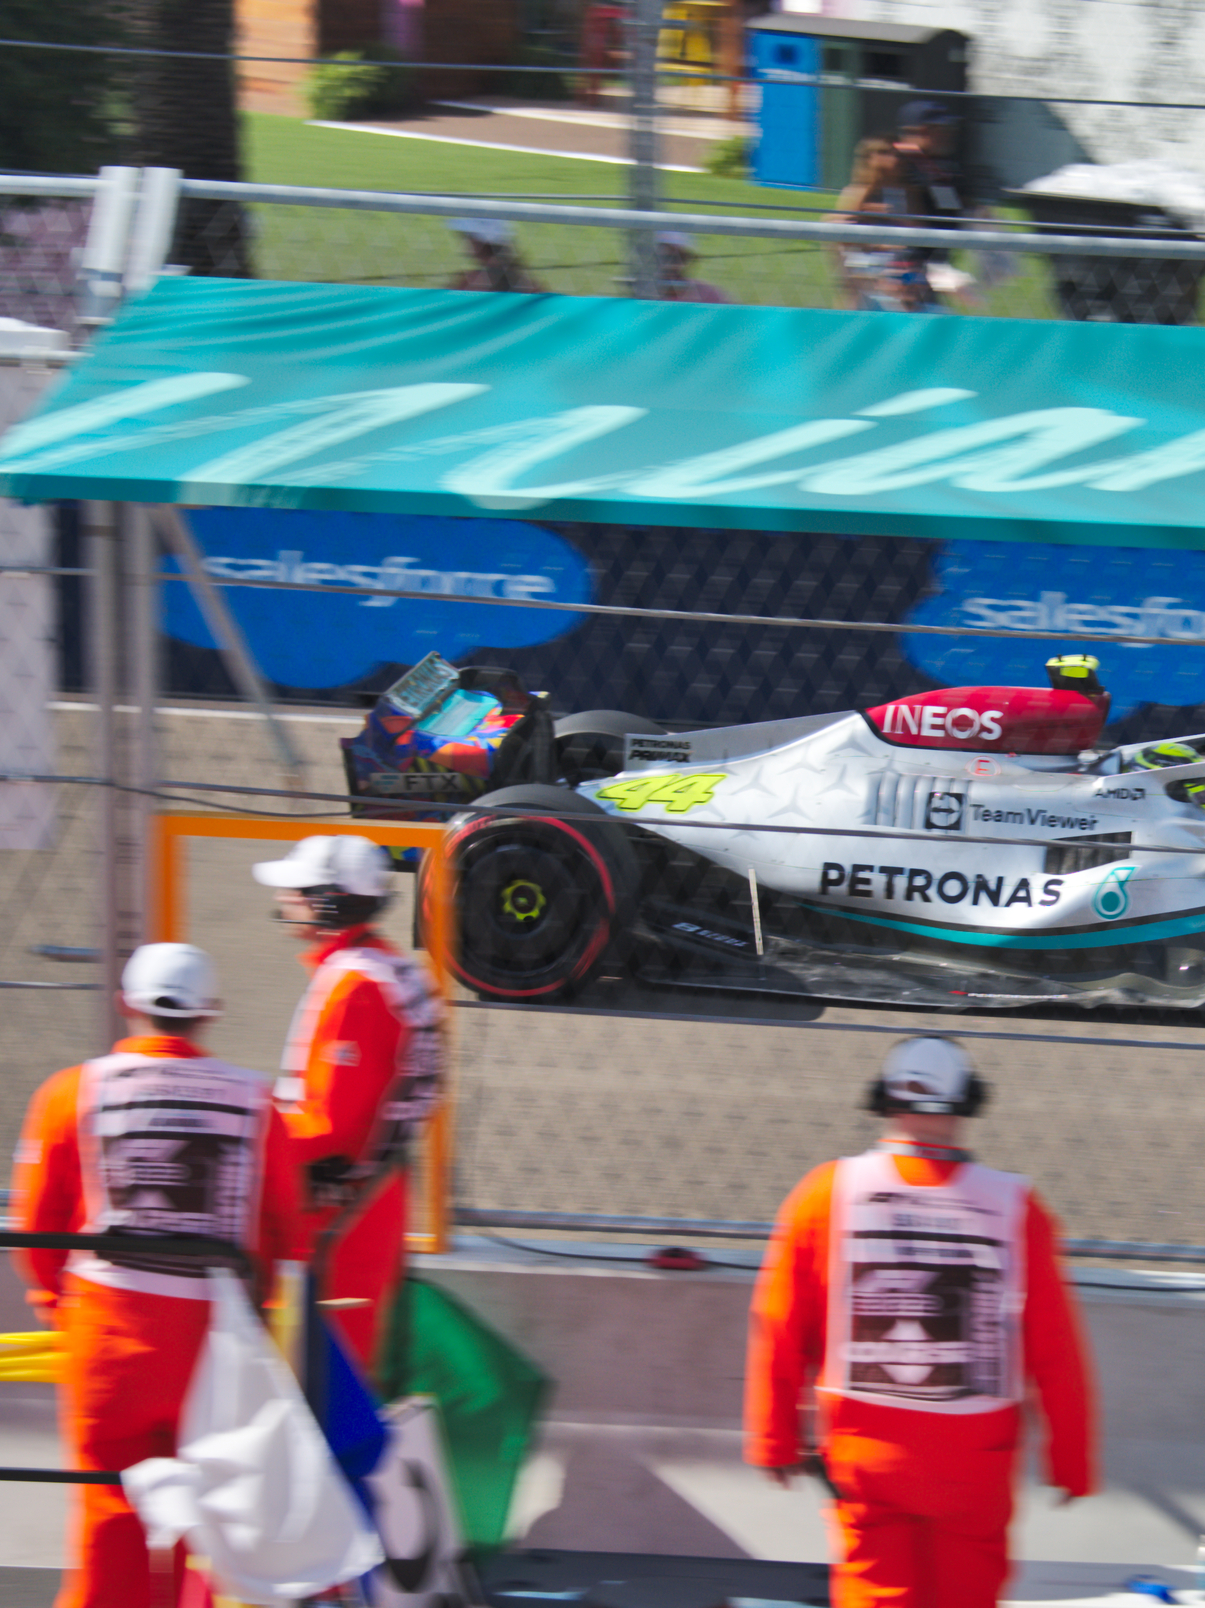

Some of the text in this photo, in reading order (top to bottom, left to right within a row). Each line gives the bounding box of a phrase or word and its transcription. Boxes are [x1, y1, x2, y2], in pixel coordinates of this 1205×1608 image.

[201, 549, 556, 607] salesforce
[882, 704, 1004, 741] INEOS
[405, 774, 461, 791] FTX
[595, 773, 727, 813] 44
[970, 803, 1098, 831] TeamViewer
[818, 861, 1066, 908] PETRONAS
